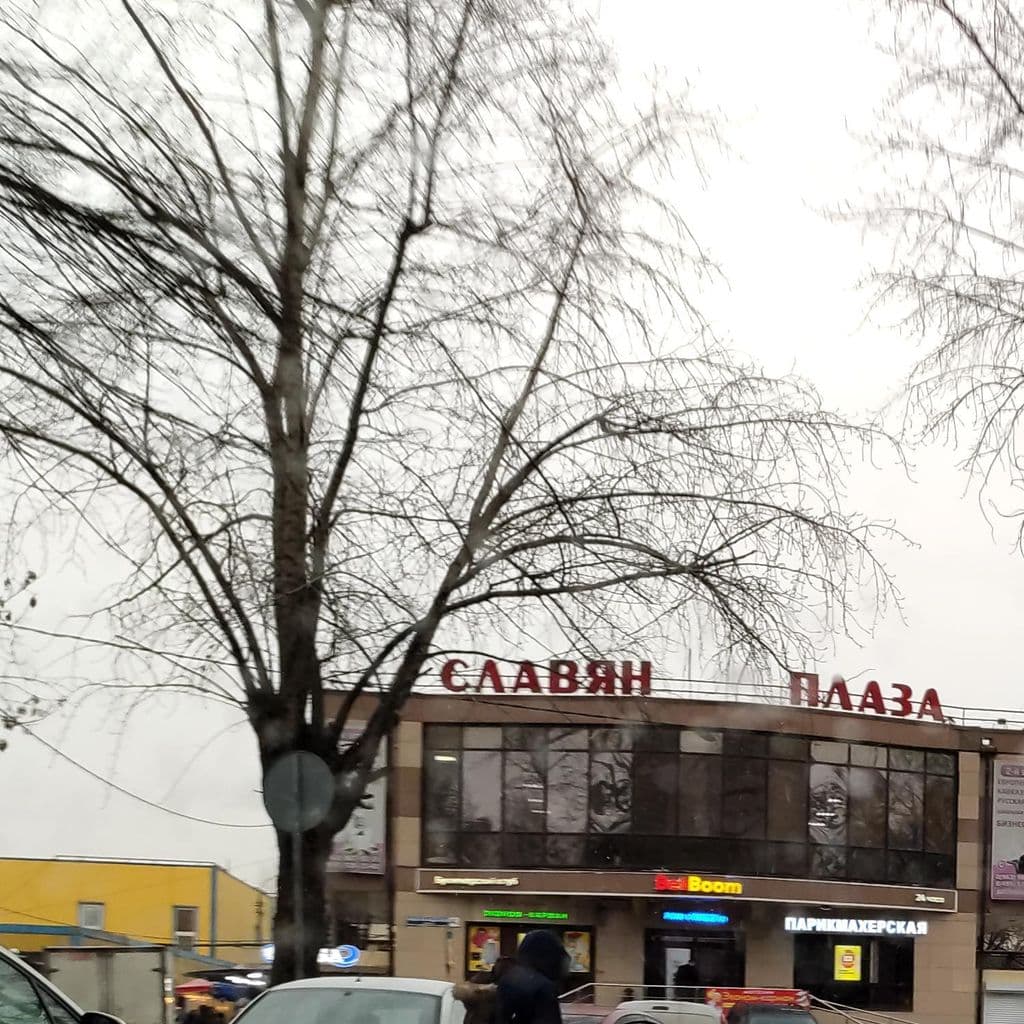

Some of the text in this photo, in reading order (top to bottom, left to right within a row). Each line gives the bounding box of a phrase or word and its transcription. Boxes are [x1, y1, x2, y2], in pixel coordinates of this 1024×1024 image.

[440, 658, 945, 722] СЛАВЯН ПЛАЗА
[784, 917, 928, 935] ПАРИКМАХЕРСКАЯ
